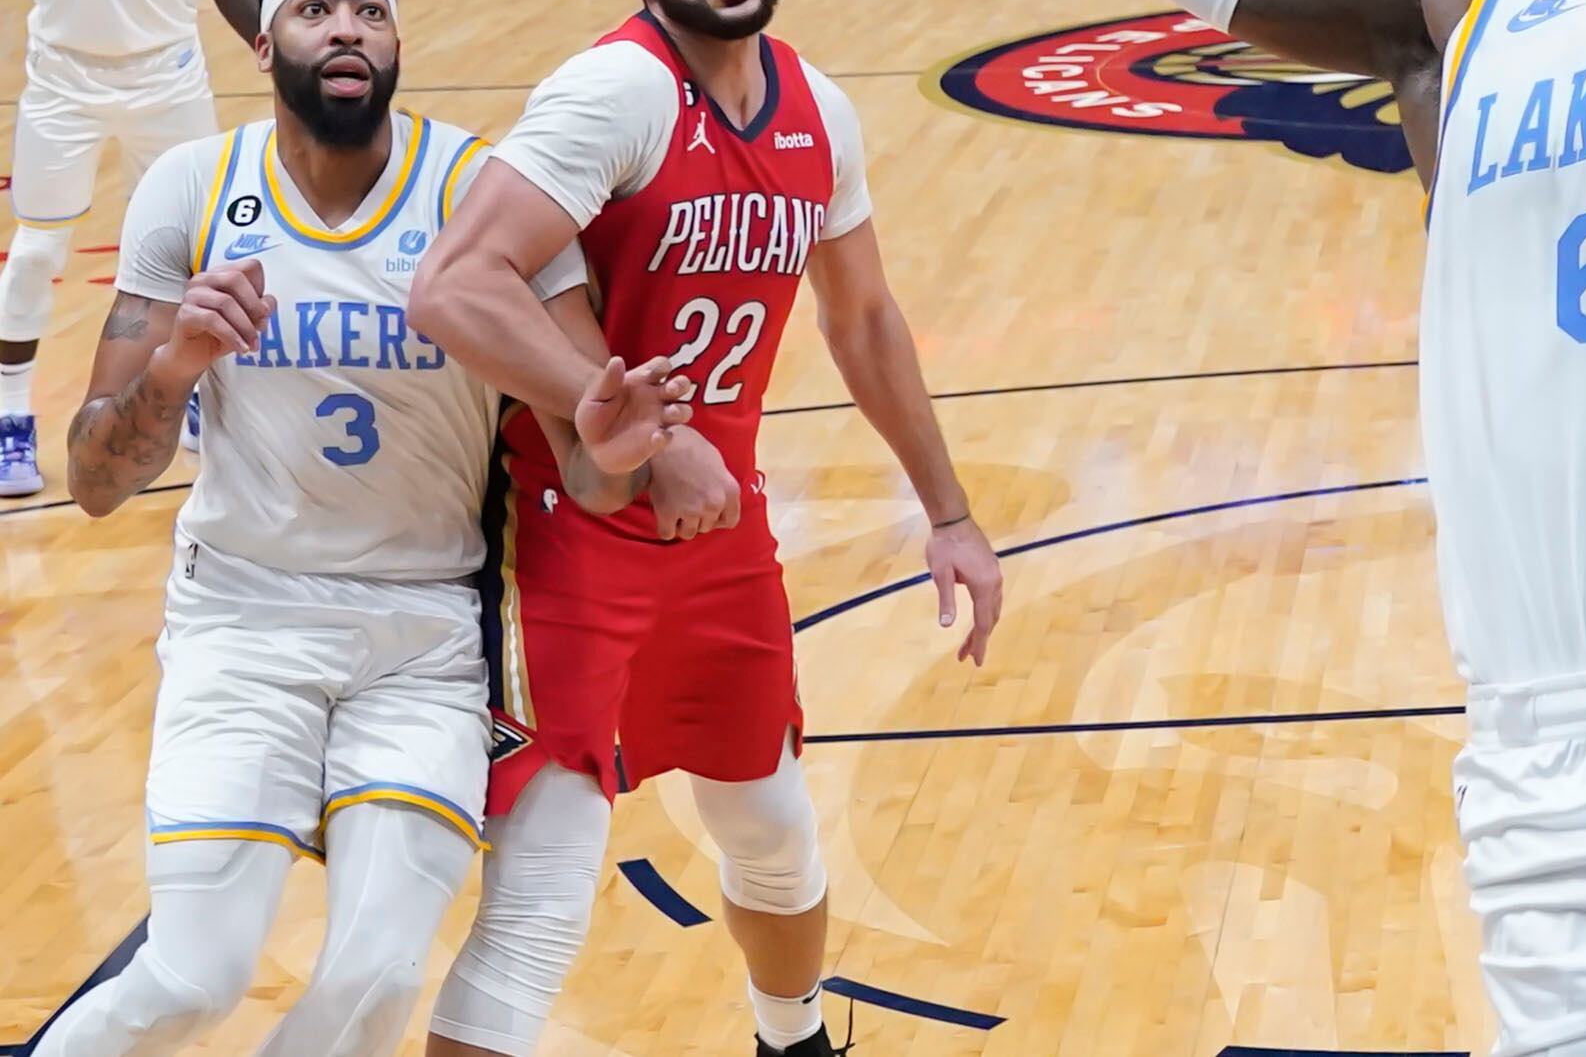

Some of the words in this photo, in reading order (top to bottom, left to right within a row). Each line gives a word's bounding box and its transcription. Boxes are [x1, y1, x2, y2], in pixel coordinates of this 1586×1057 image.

[774, 131, 814, 151] ibotta
[237, 198, 257, 225] 6
[660, 295, 767, 406] 22
[315, 393, 381, 467] 3
